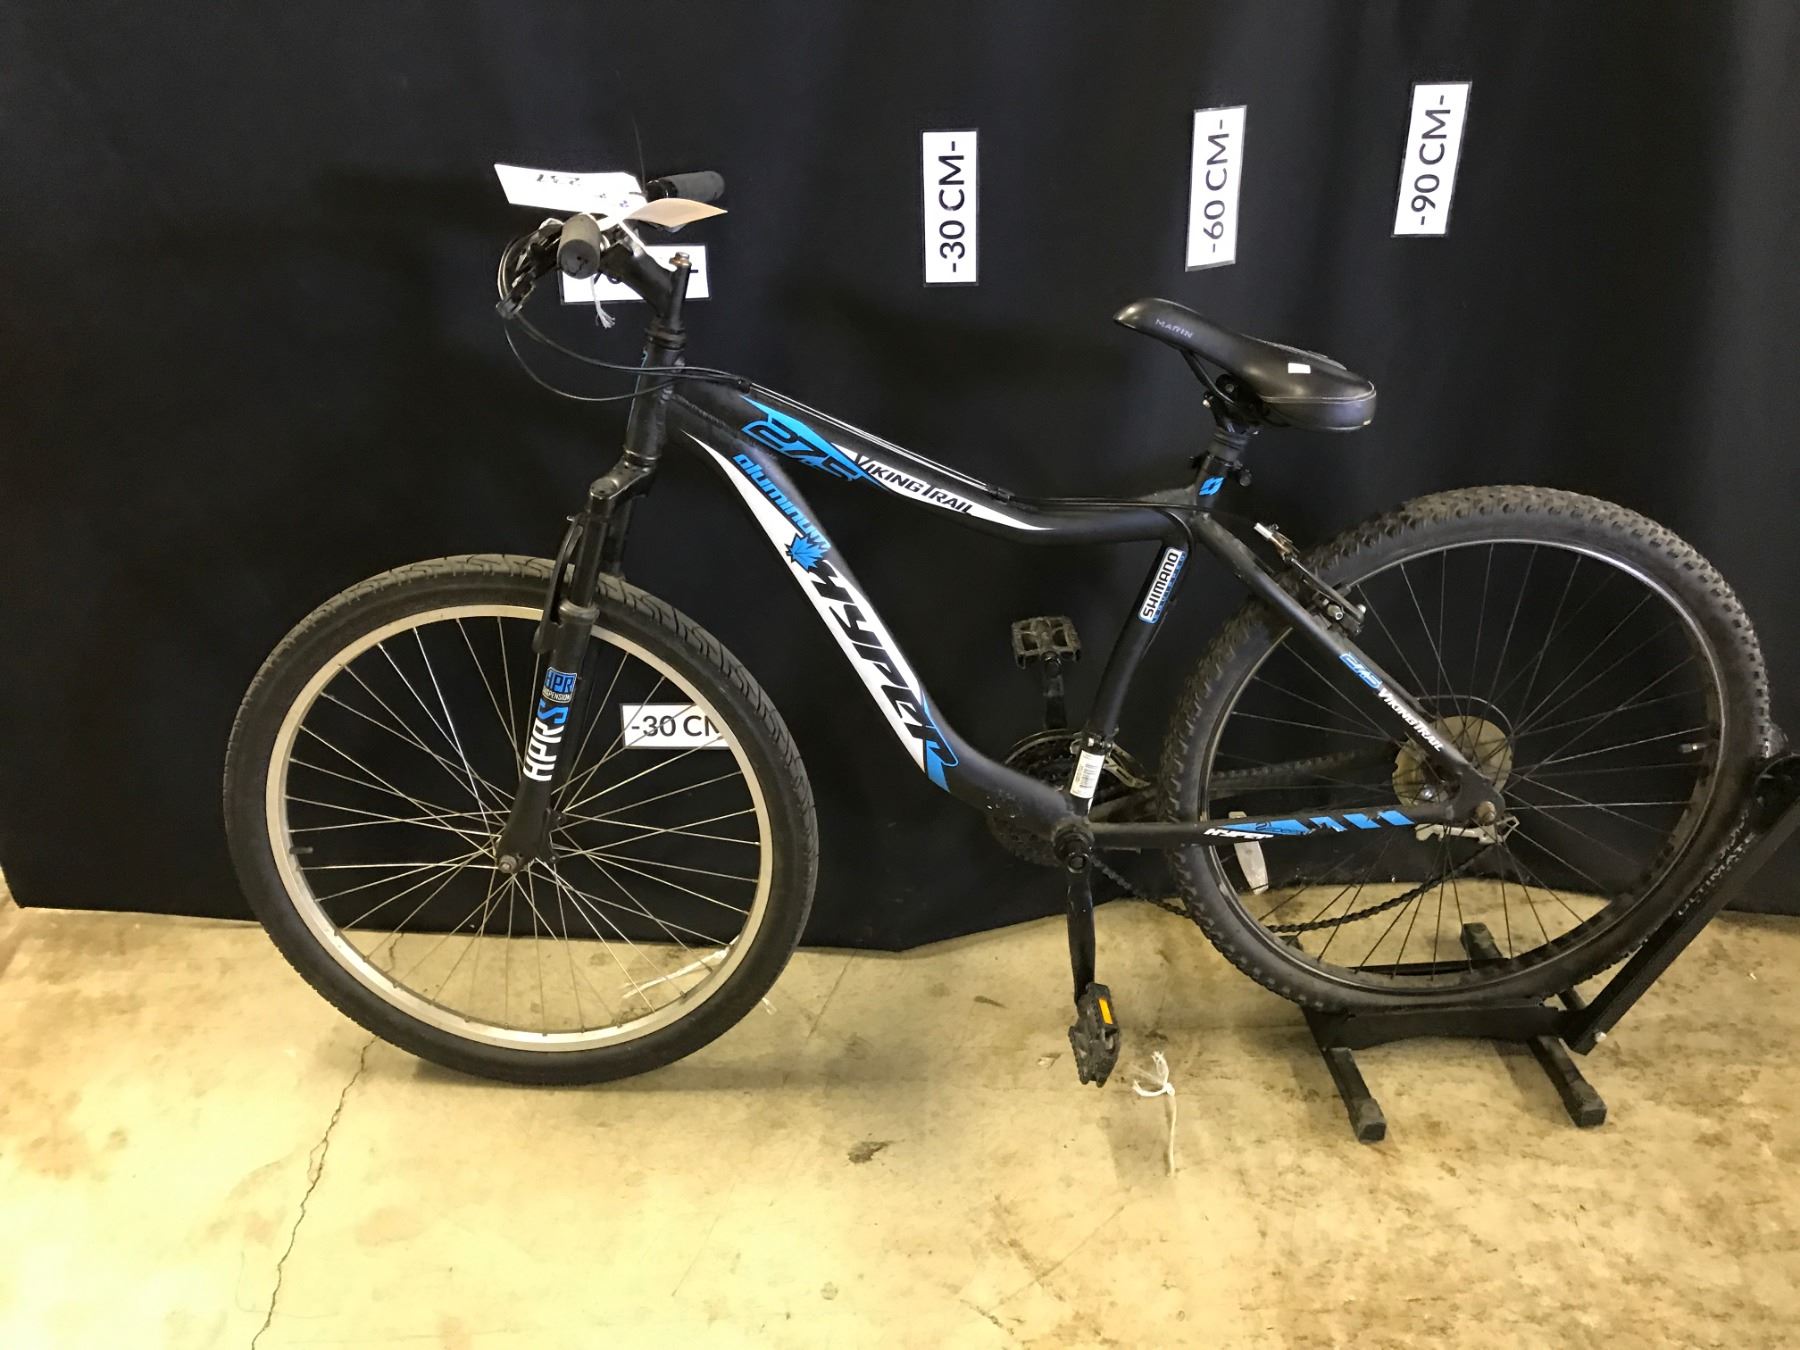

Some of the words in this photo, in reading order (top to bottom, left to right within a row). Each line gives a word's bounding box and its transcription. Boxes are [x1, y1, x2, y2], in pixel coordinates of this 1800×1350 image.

[1205, 119, 1230, 192] CM-
[1419, 94, 1452, 167] CM-
[938, 141, 965, 212] CM-
[1411, 173, 1440, 226] -90
[939, 219, 966, 273] -30
[1203, 199, 1226, 254] -60
[1155, 318, 1194, 339] MARIN
[1143, 551, 1179, 619] SHIMANO
[631, 715, 677, 737] -30
[1677, 831, 1756, 916] ULTIMATE
